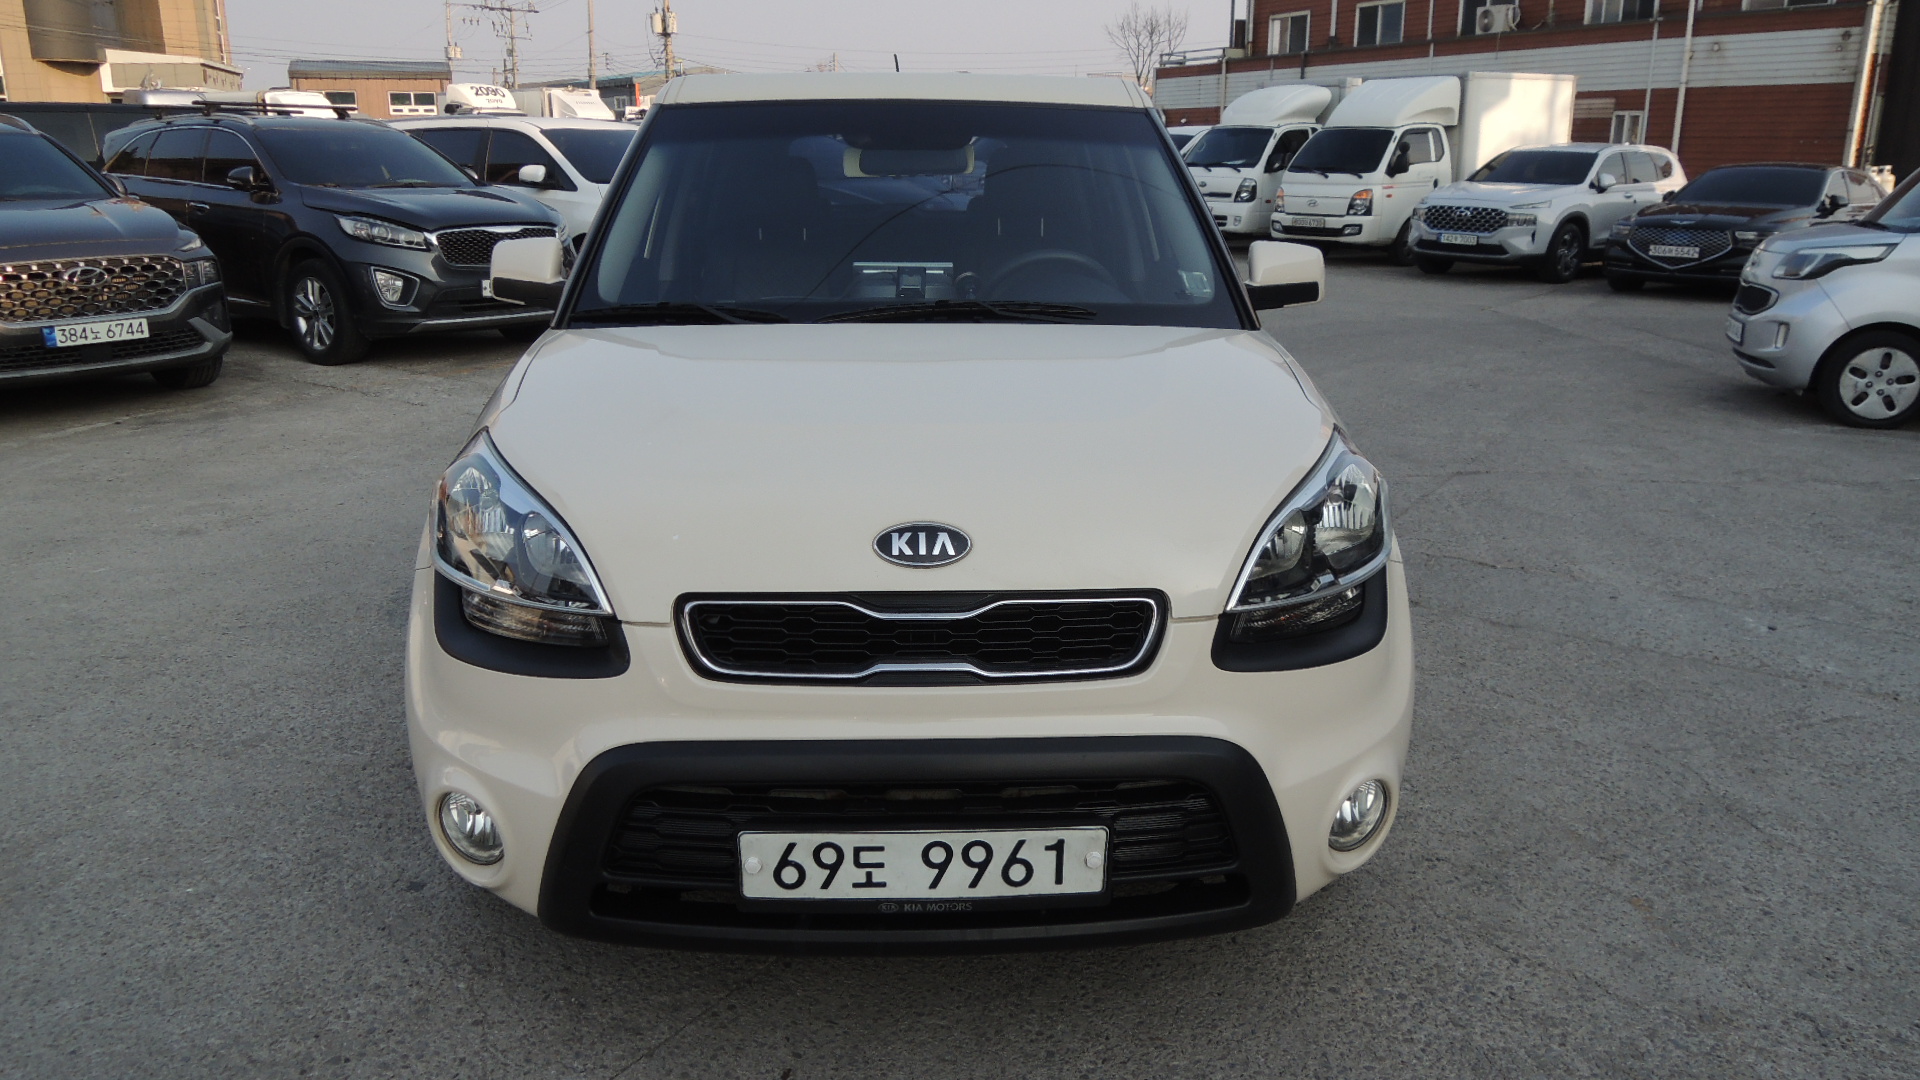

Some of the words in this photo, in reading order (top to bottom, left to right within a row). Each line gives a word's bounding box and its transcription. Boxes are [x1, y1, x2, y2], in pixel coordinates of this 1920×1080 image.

[470, 85, 506, 98] 2090
[57, 326, 102, 344] 384노
[106, 321, 145, 339] 6744
[890, 532, 956, 556] KIA
[772, 841, 888, 890] 69도
[920, 838, 1066, 889] 9961
[903, 903, 923, 912] KIA
[926, 902, 973, 911] MOTORS
